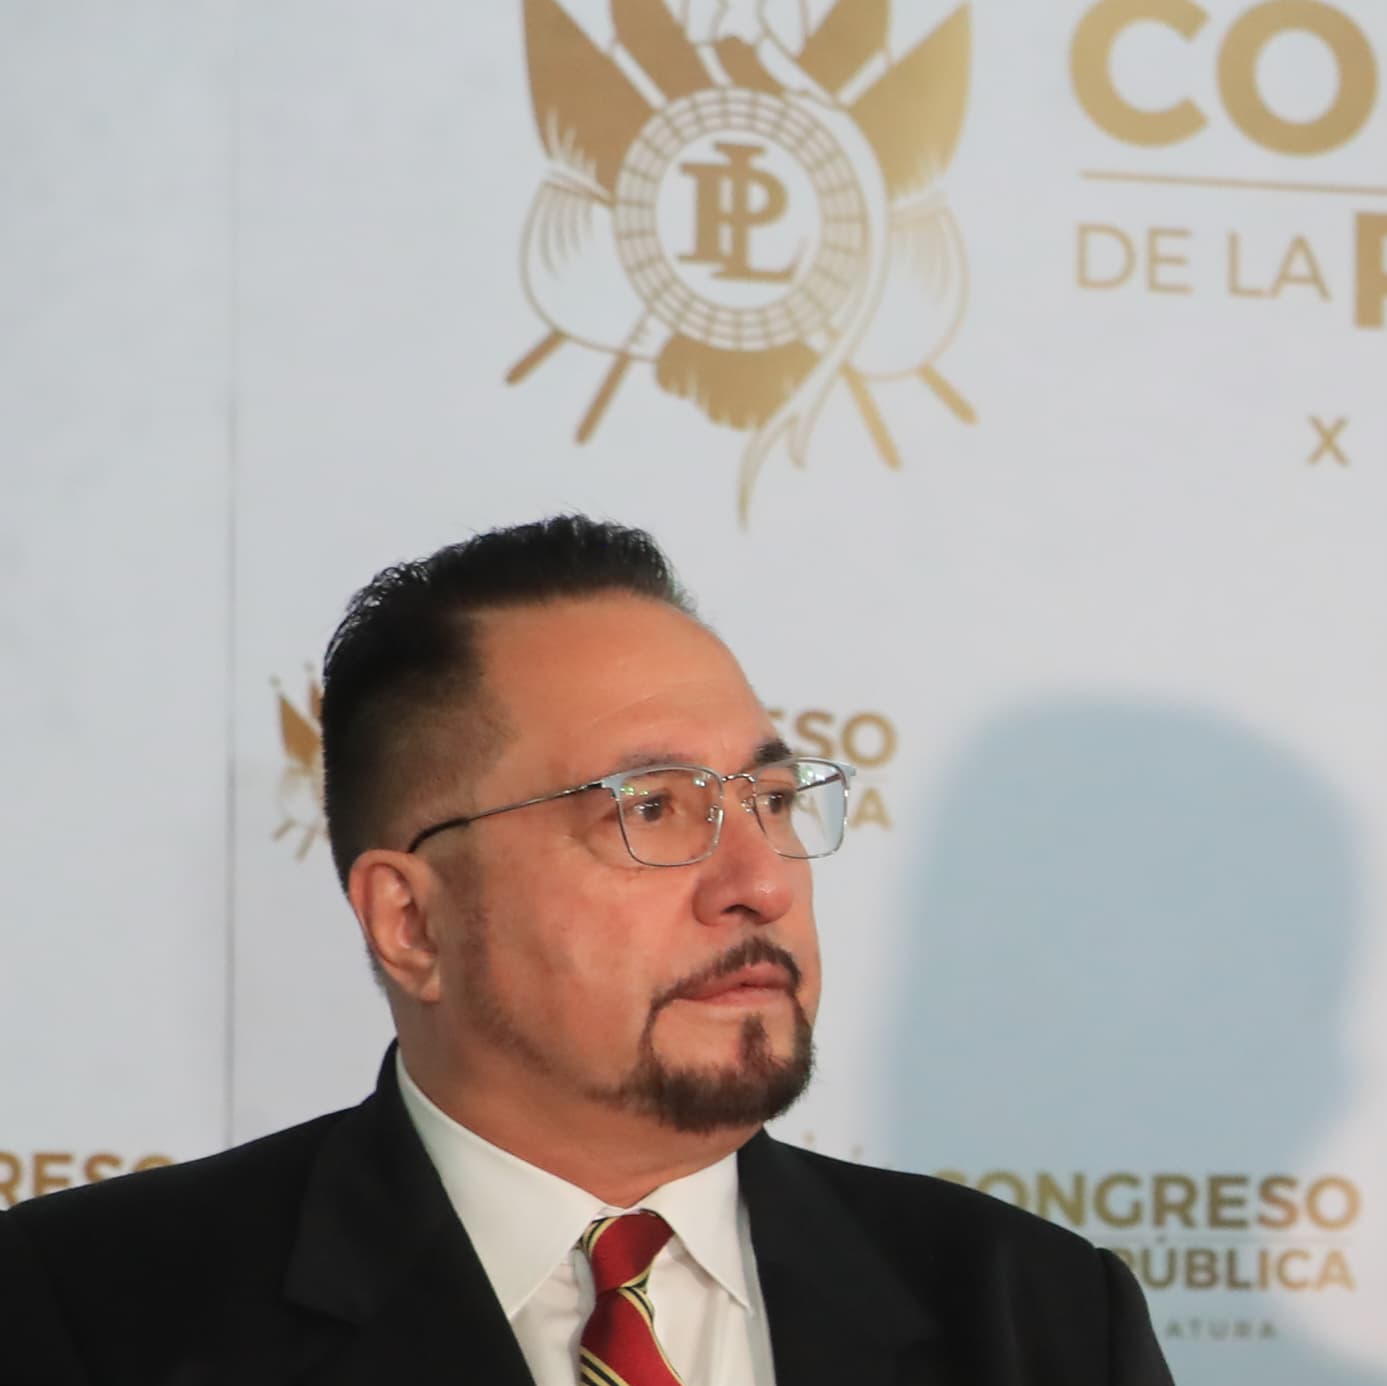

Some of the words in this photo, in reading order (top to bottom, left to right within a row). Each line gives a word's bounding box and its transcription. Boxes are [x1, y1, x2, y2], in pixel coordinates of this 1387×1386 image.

[1075, 221, 1193, 292] DE
[1227, 228, 1332, 302] LA
[1306, 416, 1351, 467] X
